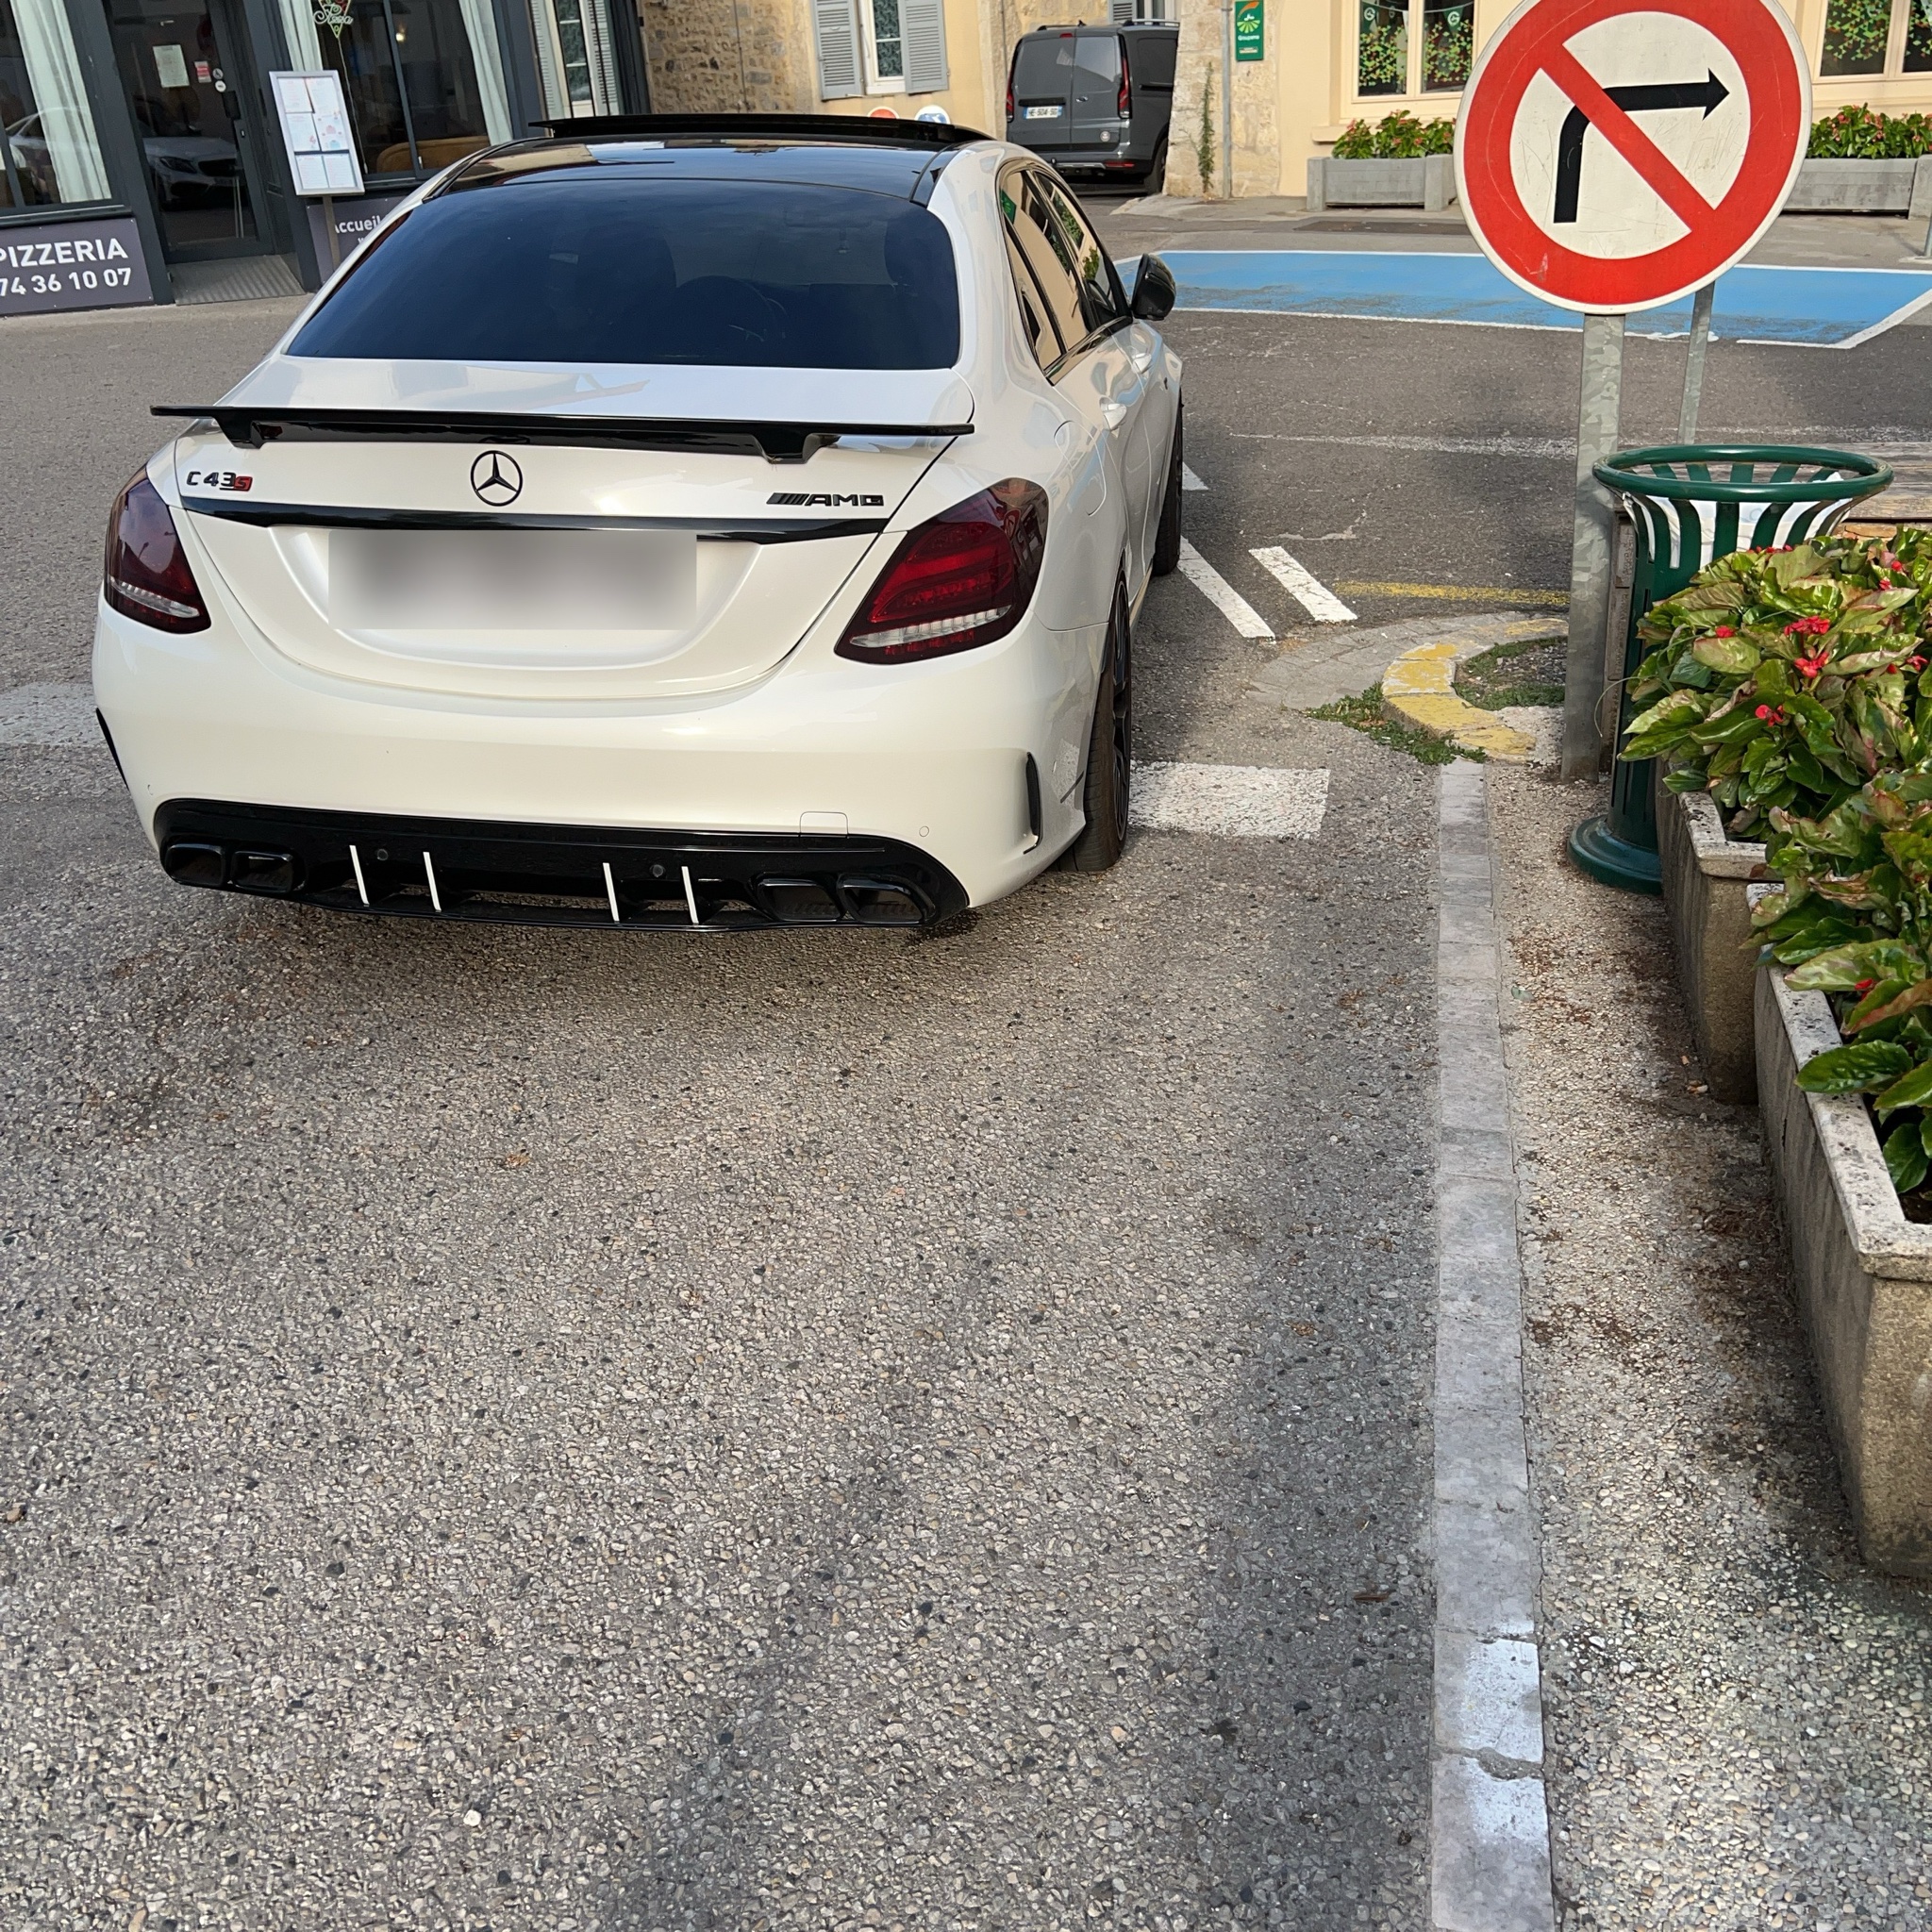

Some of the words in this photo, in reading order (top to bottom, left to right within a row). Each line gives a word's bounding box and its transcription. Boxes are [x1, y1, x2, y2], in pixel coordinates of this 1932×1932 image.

[31, 274, 62, 293] 36
[69, 270, 98, 290] 10
[103, 267, 131, 287] 07
[804, 493, 885, 507] AMG
